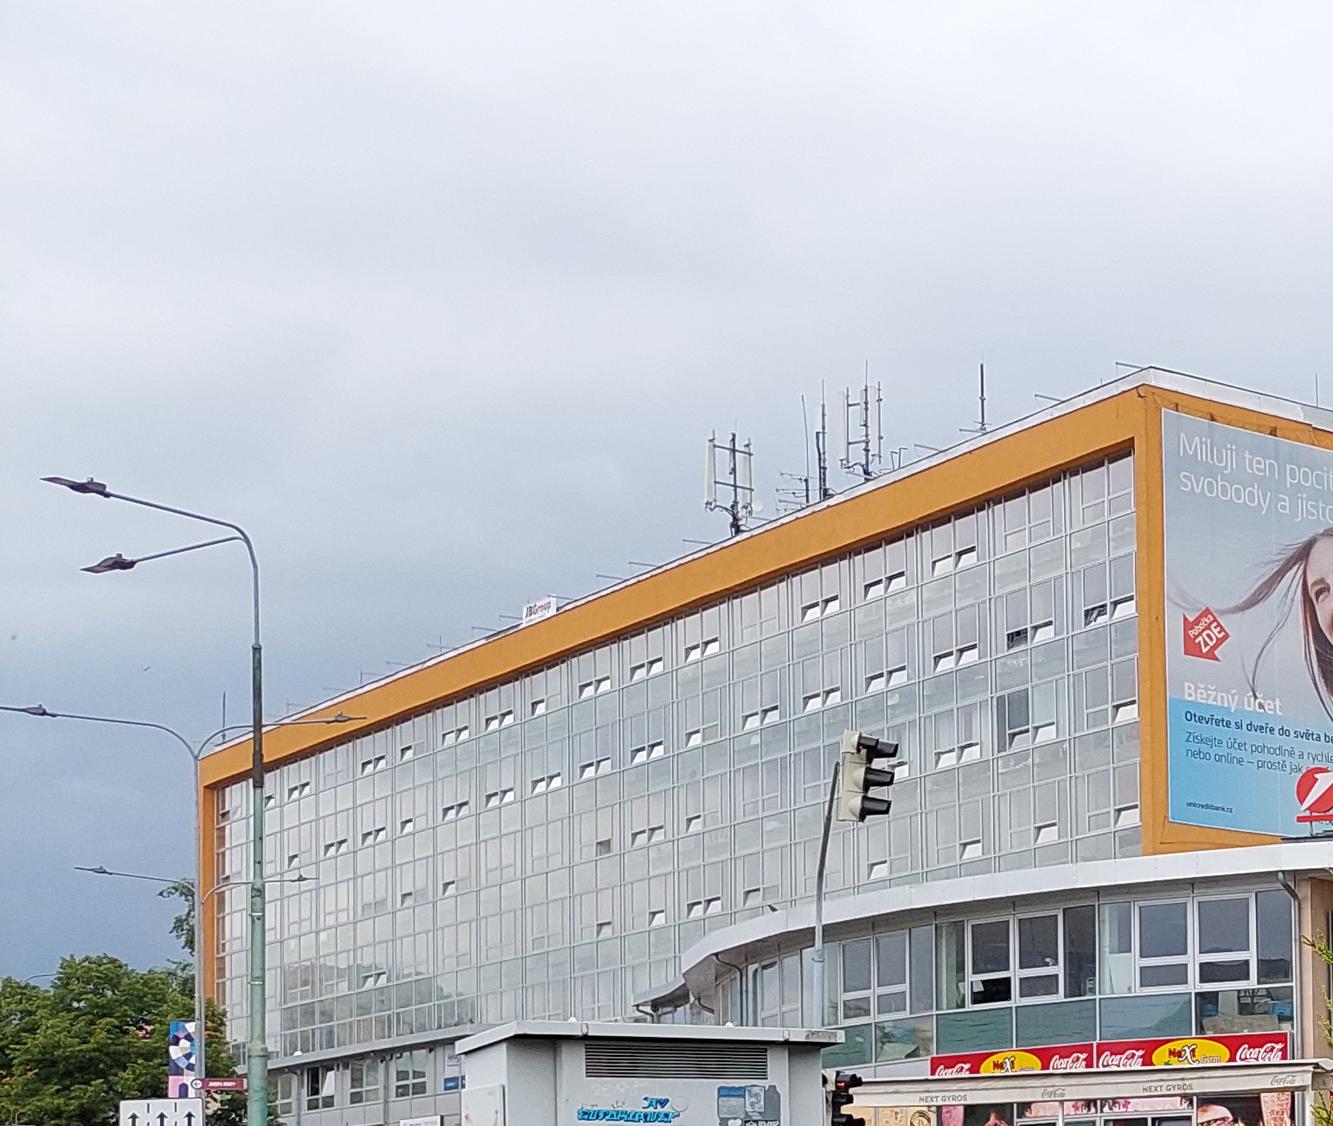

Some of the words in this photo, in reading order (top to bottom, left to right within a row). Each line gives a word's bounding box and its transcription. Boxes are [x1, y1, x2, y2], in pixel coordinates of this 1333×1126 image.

[1179, 431, 1236, 474] Miluji
[1243, 450, 1279, 480] ten
[1179, 471, 1271, 515] svobody
[1277, 493, 1290, 514] a
[1194, 621, 1227, 655] ZDE
[1183, 681, 1239, 713] Běžný
[1243, 690, 1283, 716] účet
[1184, 710, 1232, 730] Otevřete
[1234, 718, 1244, 731] si
[1246, 722, 1275, 736] dveře
[1278, 725, 1291, 738] do
[1293, 728, 1322, 743] světa
[1185, 730, 1224, 749] Získejte
[1226, 735, 1248, 751] účet
[1250, 742, 1296, 760] pohodlně
[1298, 751, 1304, 760] a
[1185, 747, 1212, 761] nebo
[1214, 750, 1245, 766] online
[1256, 758, 1288, 773] prostě
[1289, 761, 1303, 776] jak
[1098, 1049, 1146, 1069] Coca-Cola
[1235, 1041, 1285, 1063] Coca-Cola
[919, 1095, 940, 1103] NEXT
[941, 1094, 968, 1102] GYROS
[1142, 1084, 1164, 1093] NEXT
[1166, 1083, 1193, 1092] GYROS
